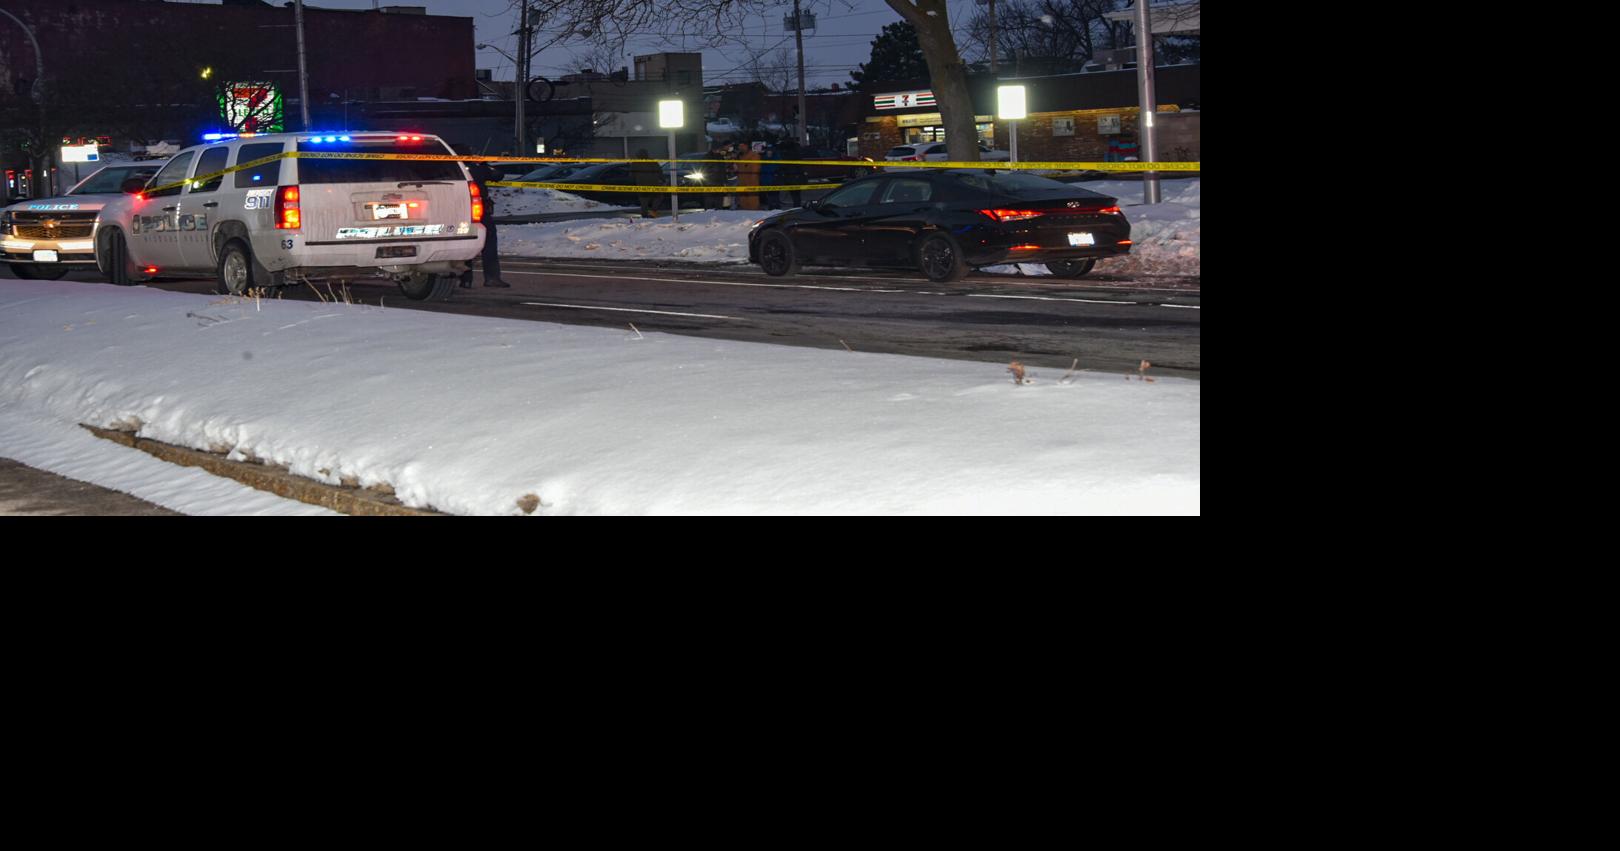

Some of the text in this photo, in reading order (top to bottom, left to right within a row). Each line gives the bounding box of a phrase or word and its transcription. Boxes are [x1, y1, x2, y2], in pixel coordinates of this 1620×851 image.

[901, 95, 910, 106] 7
[28, 203, 80, 211] POLICE
[244, 196, 271, 209] 911
[141, 213, 208, 233] POLICE
[281, 239, 294, 250] 63
